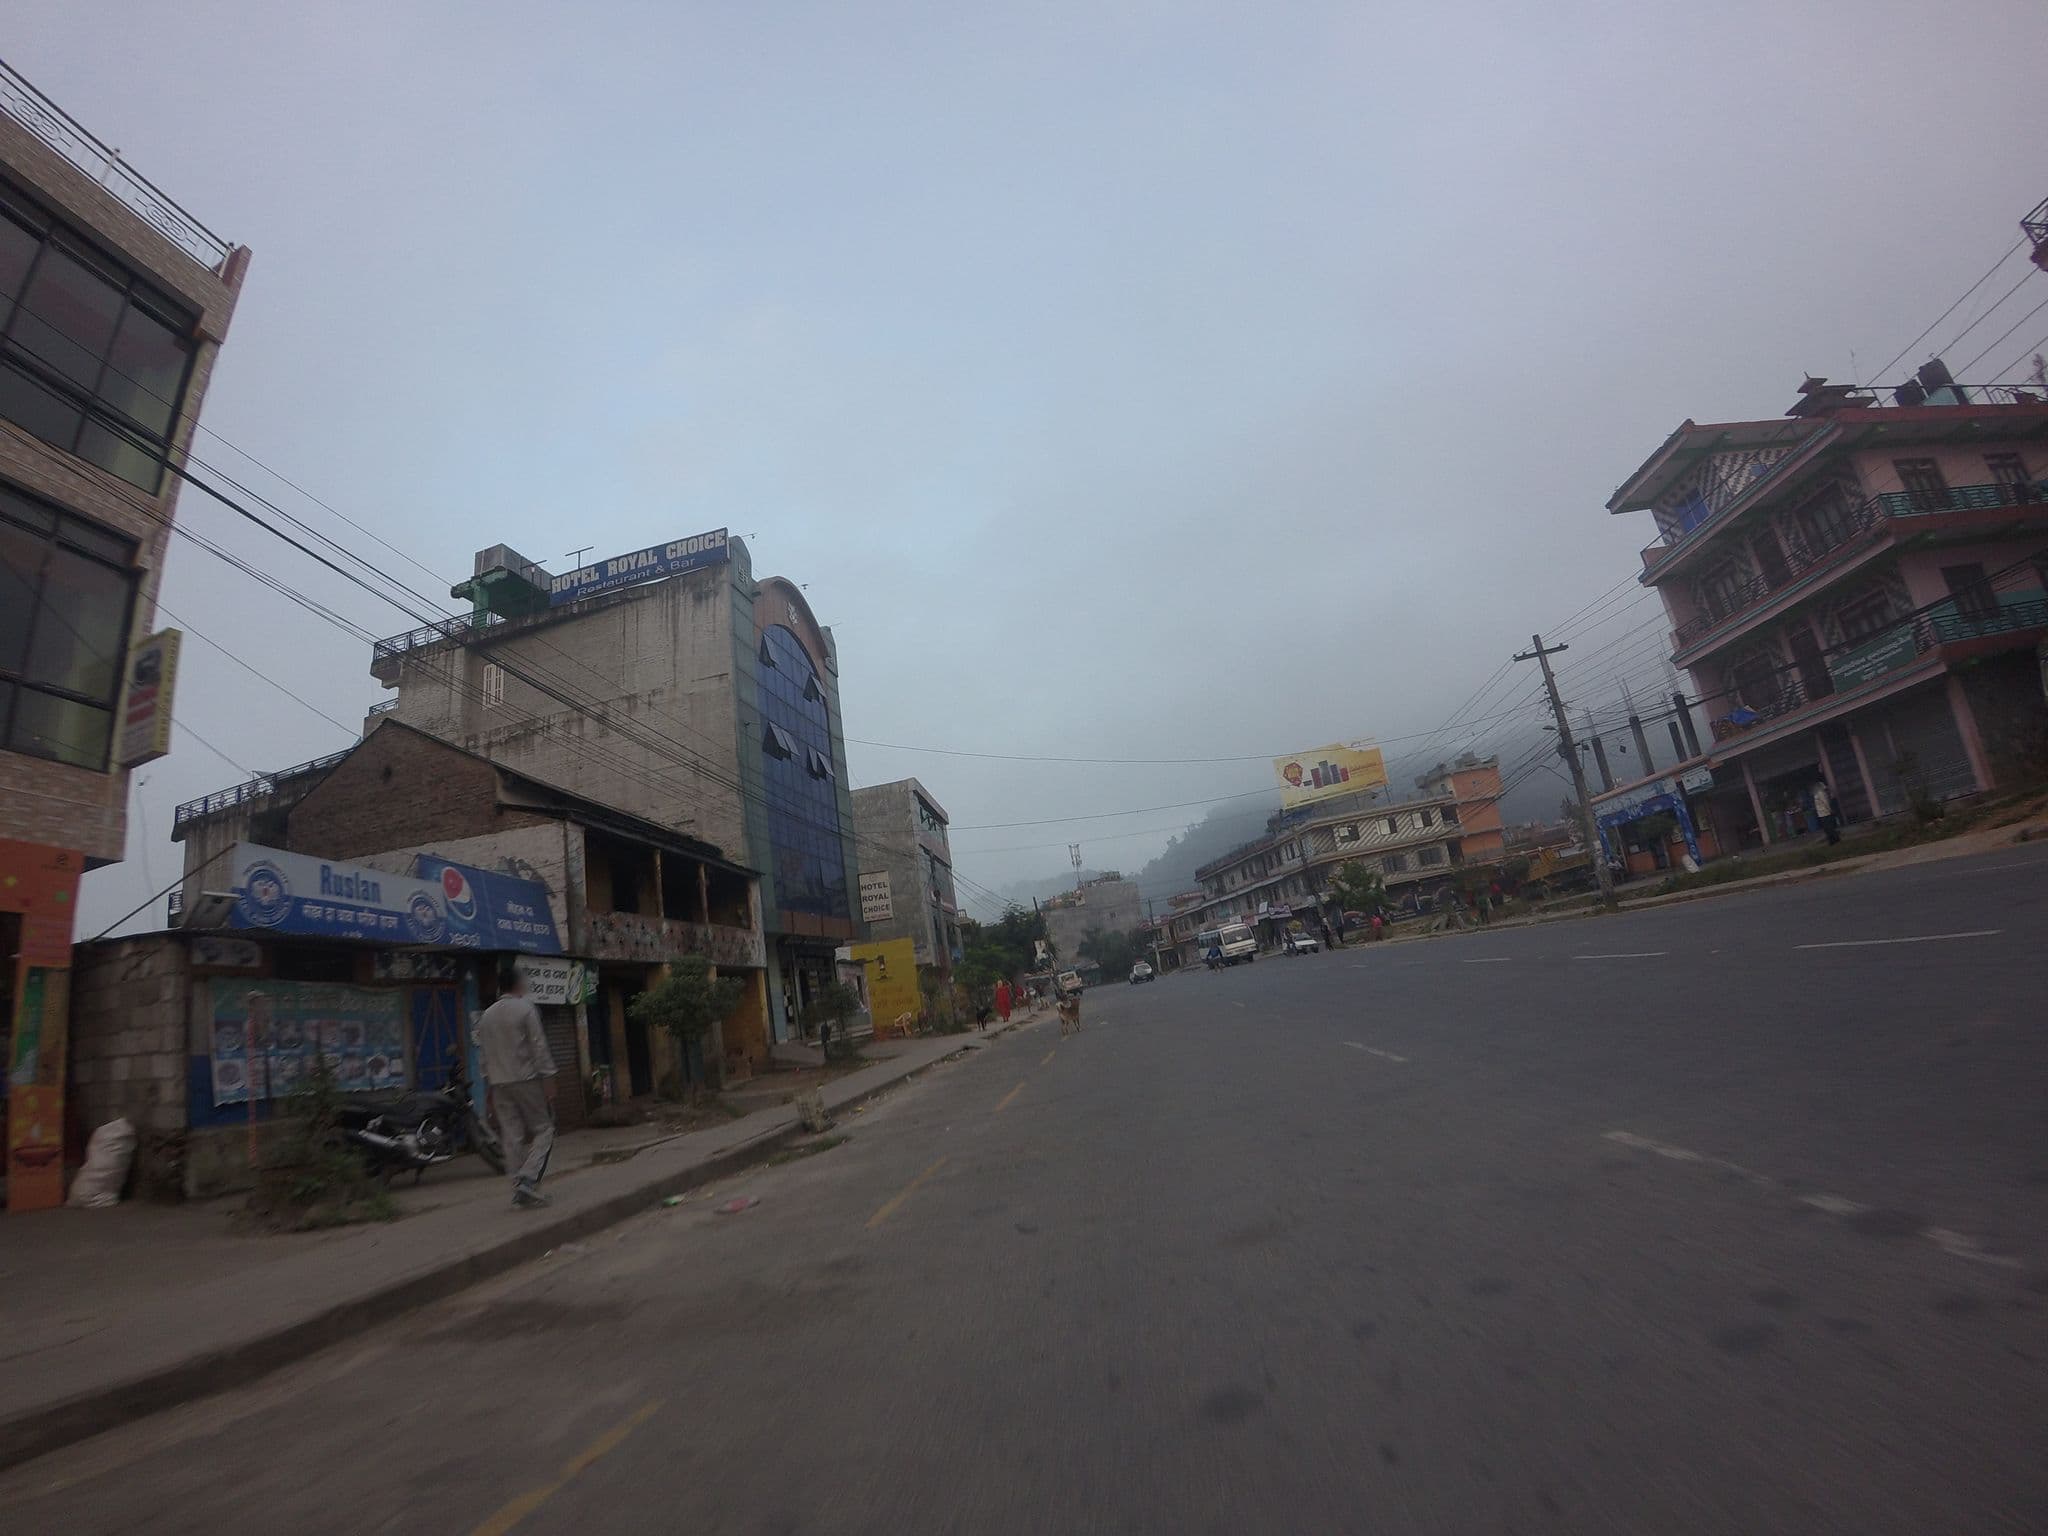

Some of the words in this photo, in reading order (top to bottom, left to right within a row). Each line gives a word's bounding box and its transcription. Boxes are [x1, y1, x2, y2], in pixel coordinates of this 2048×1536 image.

[551, 566, 600, 594] HOTEL
[607, 550, 658, 577] ROYAL
[665, 530, 726, 560] CHOICE
[577, 570, 650, 597] Restaurant
[655, 564, 665, 574] &
[670, 558, 696, 571] Bar
[319, 863, 381, 904] Ruslan
[861, 881, 889, 892] HOTEL
[862, 892, 890, 903] ROYAL
[863, 903, 891, 914] CHOICE
